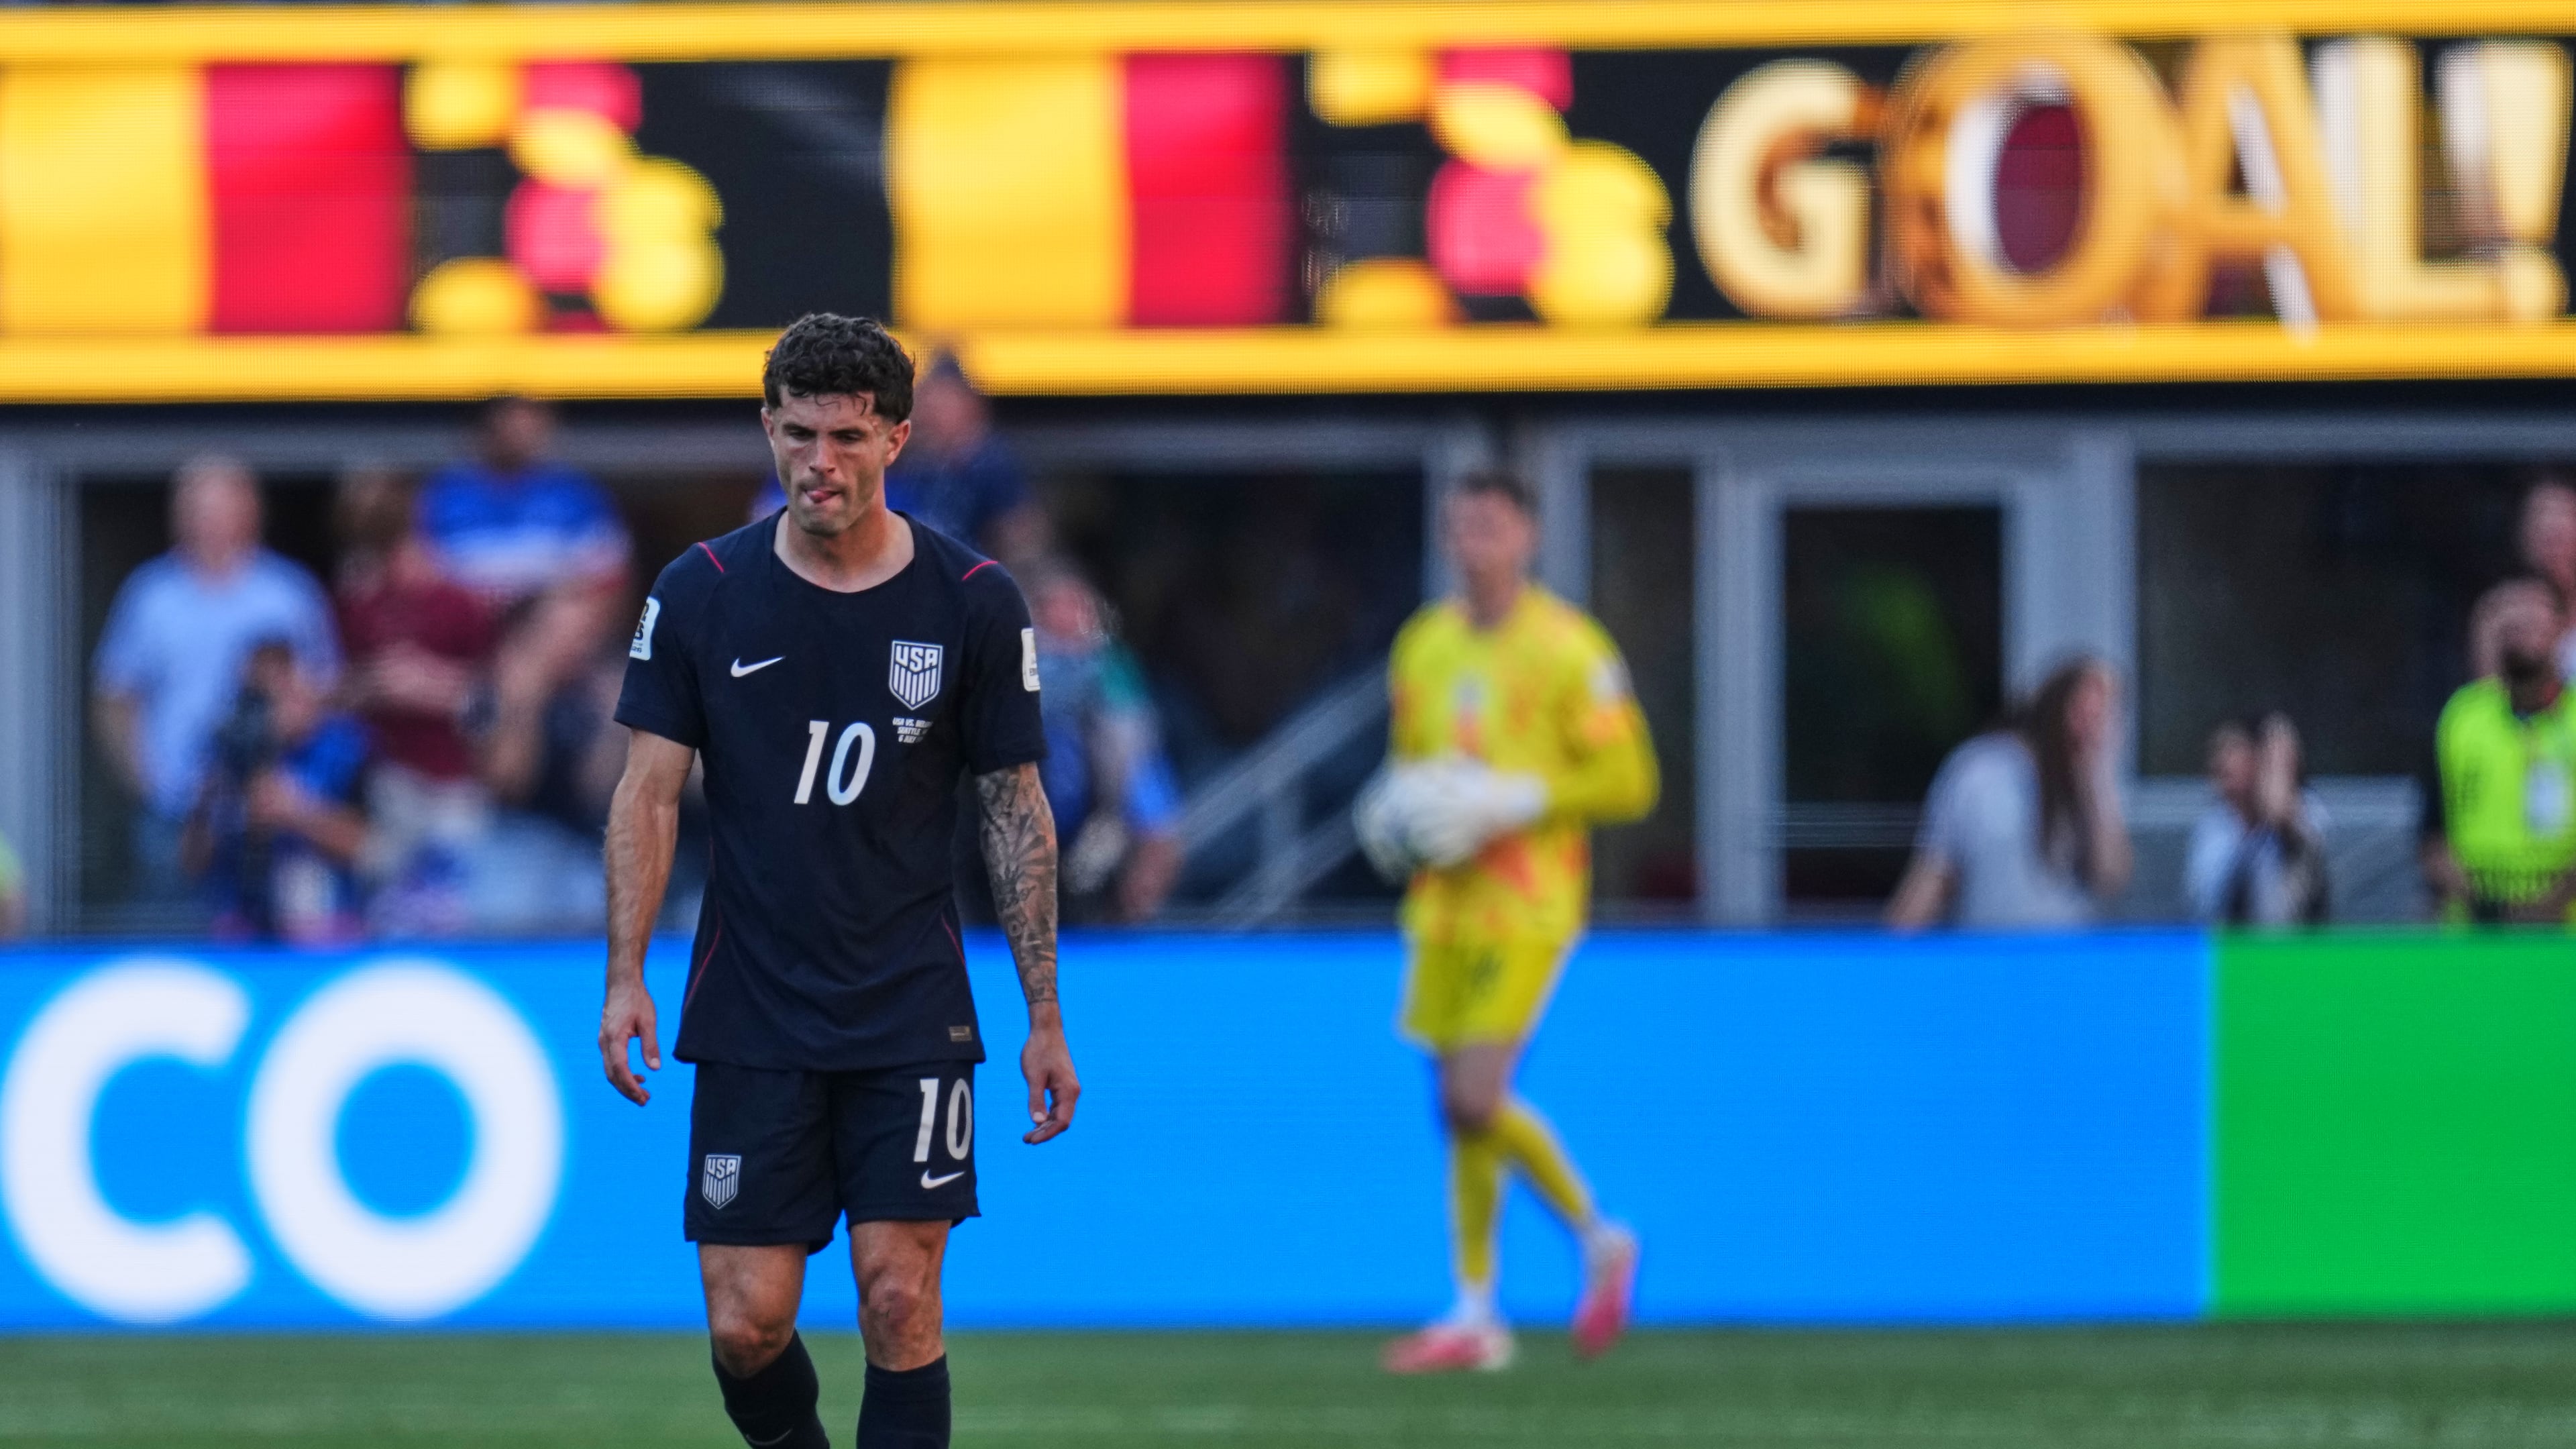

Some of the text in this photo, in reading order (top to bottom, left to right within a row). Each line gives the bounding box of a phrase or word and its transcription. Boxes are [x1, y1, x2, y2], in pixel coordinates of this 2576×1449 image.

[1689, 32, 2572, 329] GOAL!
[895, 645, 938, 672] USA
[794, 720, 875, 806] 10
[3, 958, 564, 1320] CO
[913, 1078, 972, 1162] 10
[707, 1158, 737, 1179] USA
